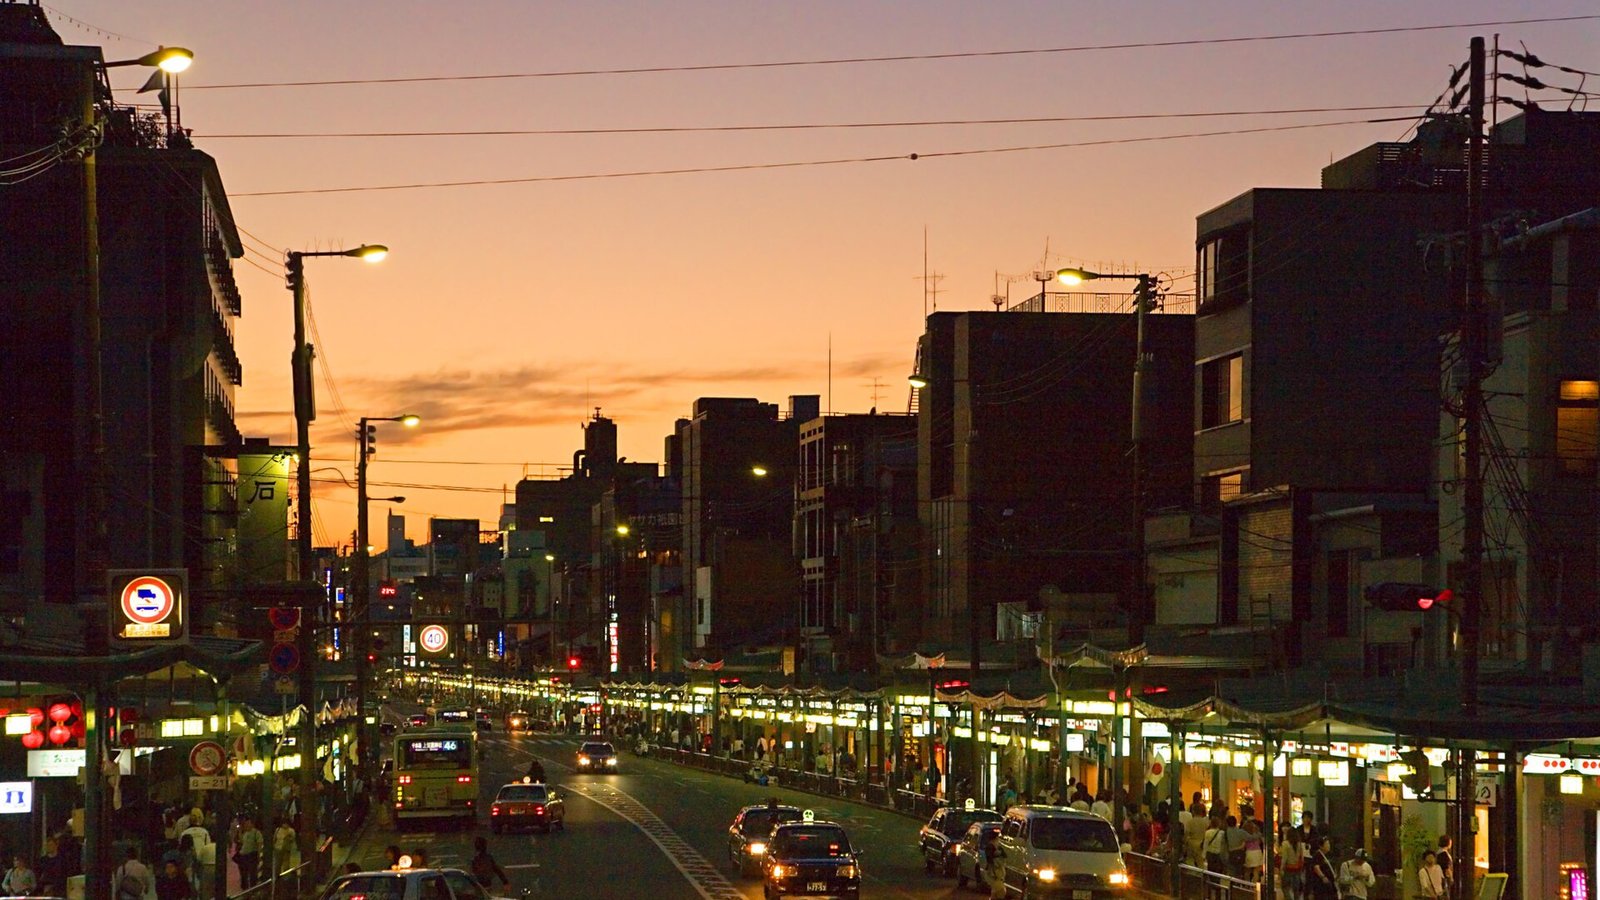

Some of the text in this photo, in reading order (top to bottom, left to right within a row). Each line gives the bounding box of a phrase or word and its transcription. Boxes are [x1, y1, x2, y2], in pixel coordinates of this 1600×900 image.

[247, 480, 276, 504] 石
[427, 633, 441, 645] 40
[444, 740, 457, 751] 46
